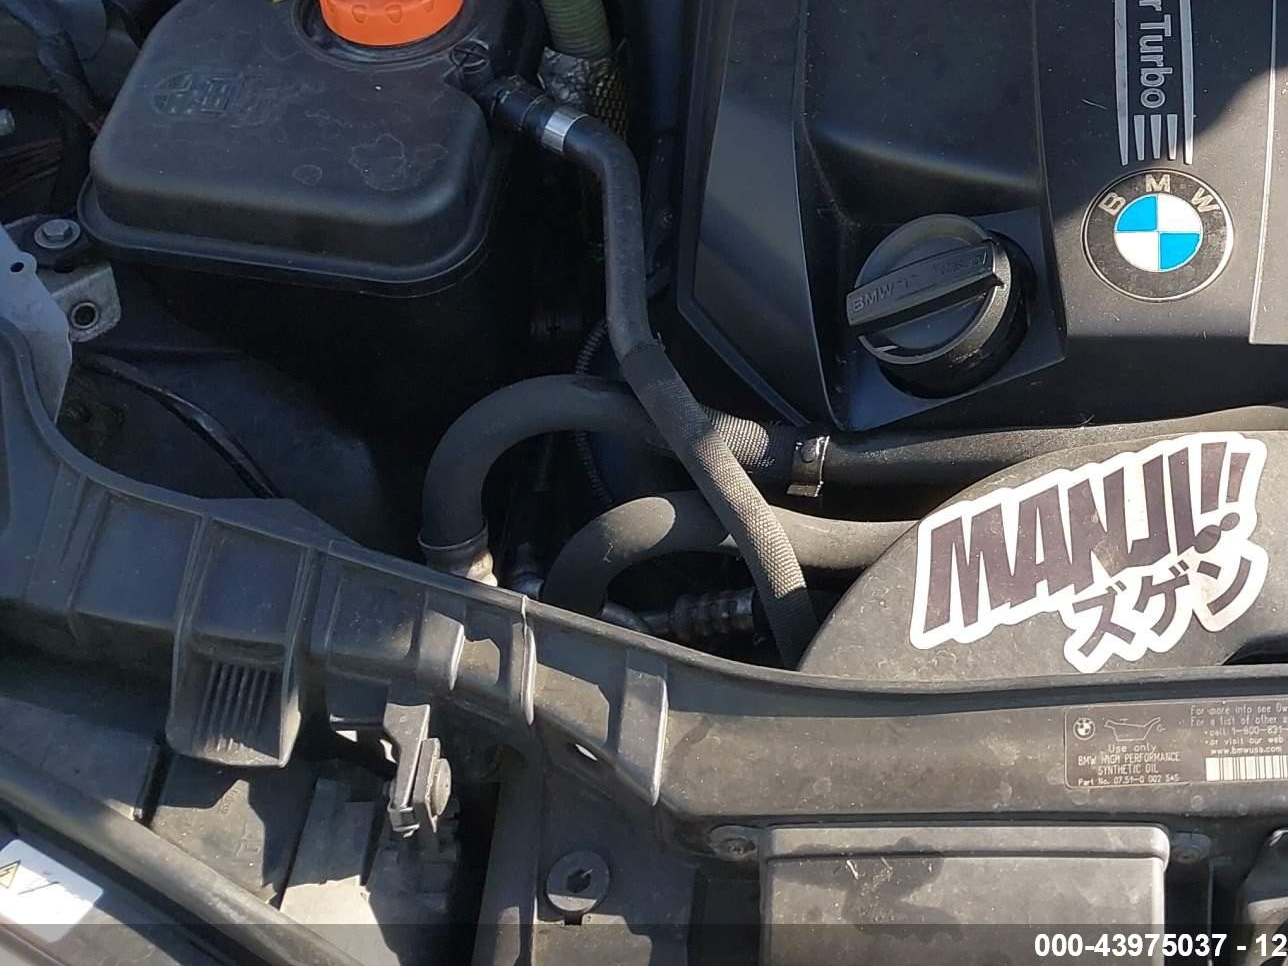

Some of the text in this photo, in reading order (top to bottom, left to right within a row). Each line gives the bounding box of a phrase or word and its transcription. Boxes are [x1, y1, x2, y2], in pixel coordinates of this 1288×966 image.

[1139, 14, 1174, 109] Turbo
[1098, 174, 1220, 217] BMW
[1191, 705, 1204, 715] For
[1191, 716, 1205, 727] For
[1108, 742, 1157, 754] Use only
[1078, 755, 1097, 766] BMW
[1124, 751, 1181, 763] PERFORMANCE
[1098, 763, 1160, 776] SYNTHETIC OIL
[1078, 777, 1094, 786] Part
